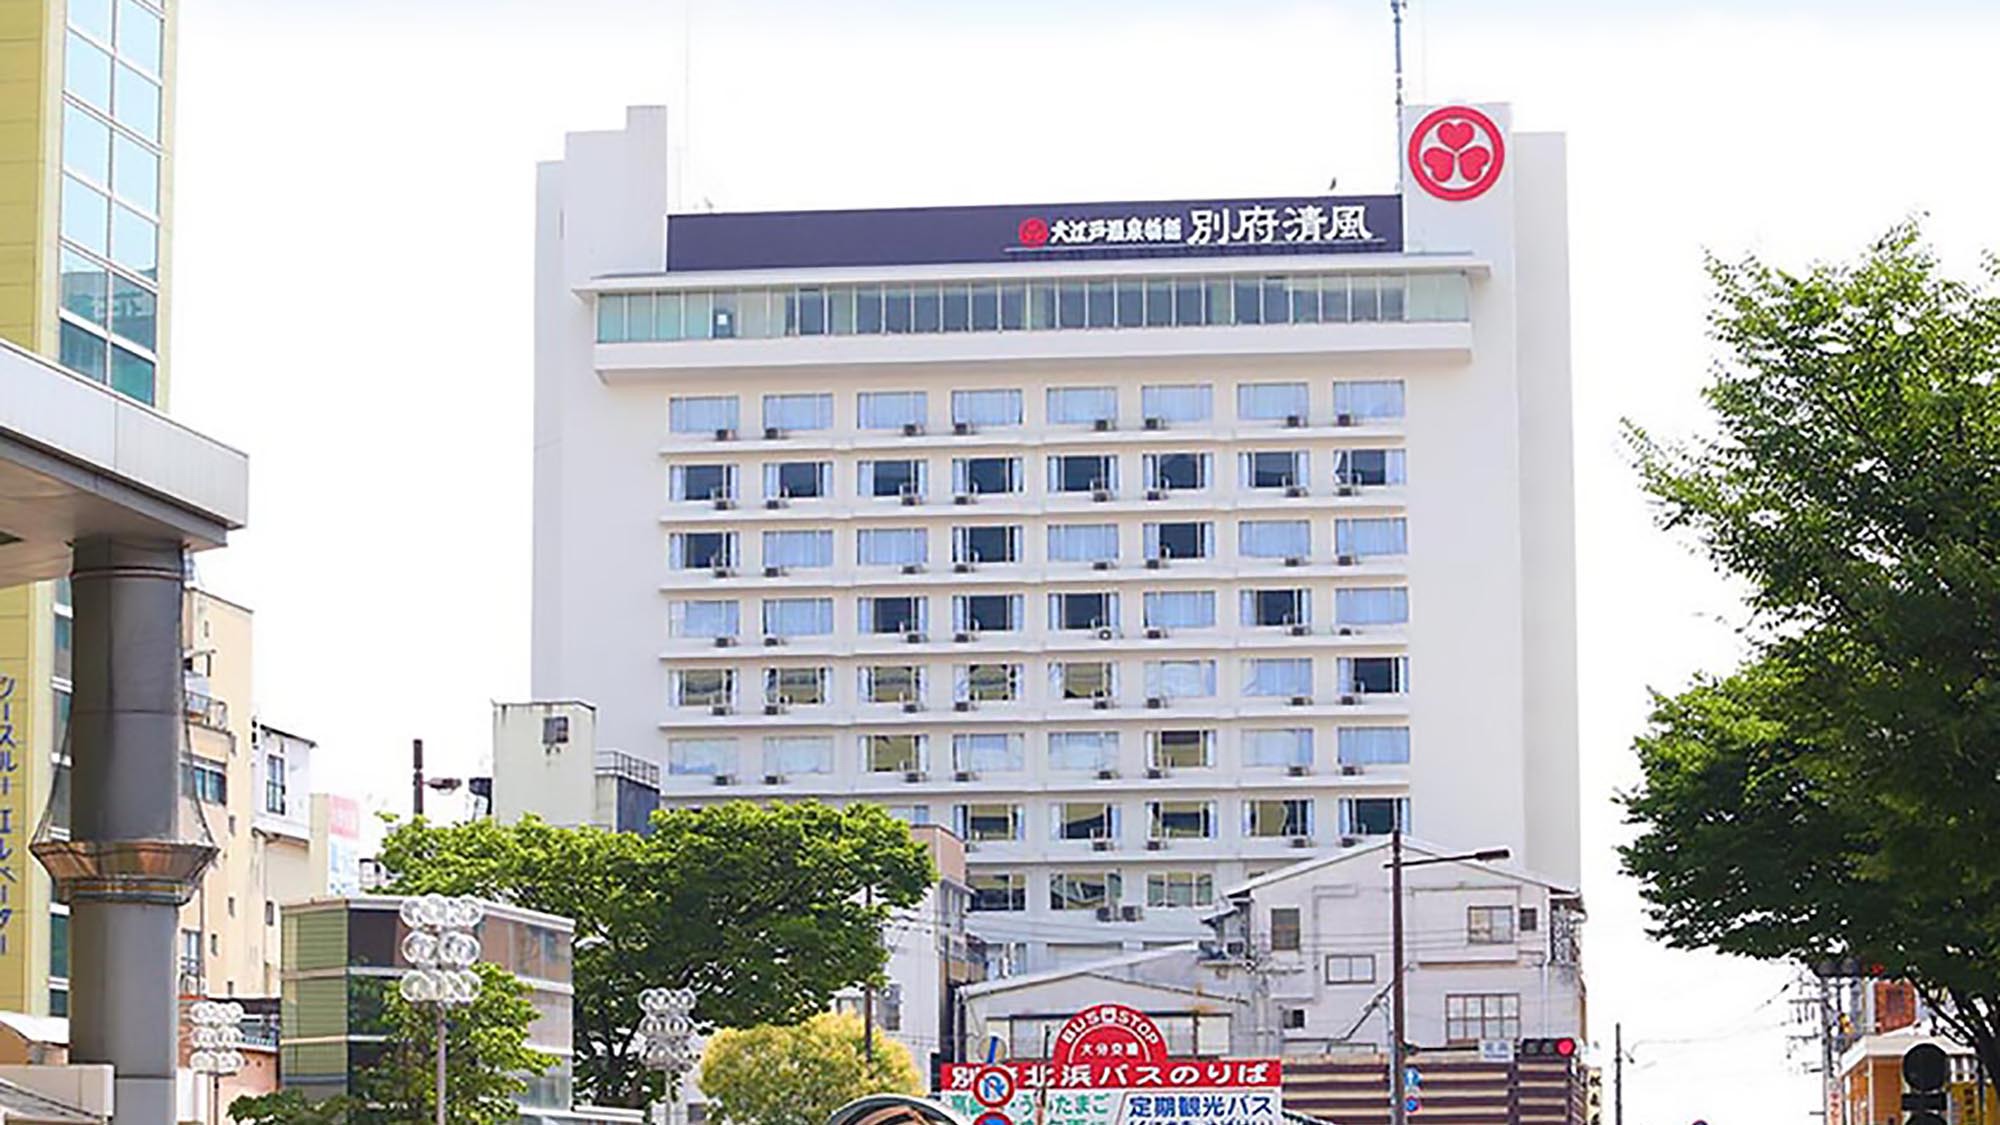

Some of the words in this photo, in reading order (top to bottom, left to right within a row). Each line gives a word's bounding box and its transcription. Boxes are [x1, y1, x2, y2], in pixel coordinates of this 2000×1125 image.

[1186, 204, 1373, 245] 別府清風
[1061, 1010, 1100, 1044] BUS
[1118, 1010, 1159, 1044] STOP
[950, 1063, 1269, 1089] 別北浜バスのりば
[1129, 1095, 1274, 1117] 定期観光バス
